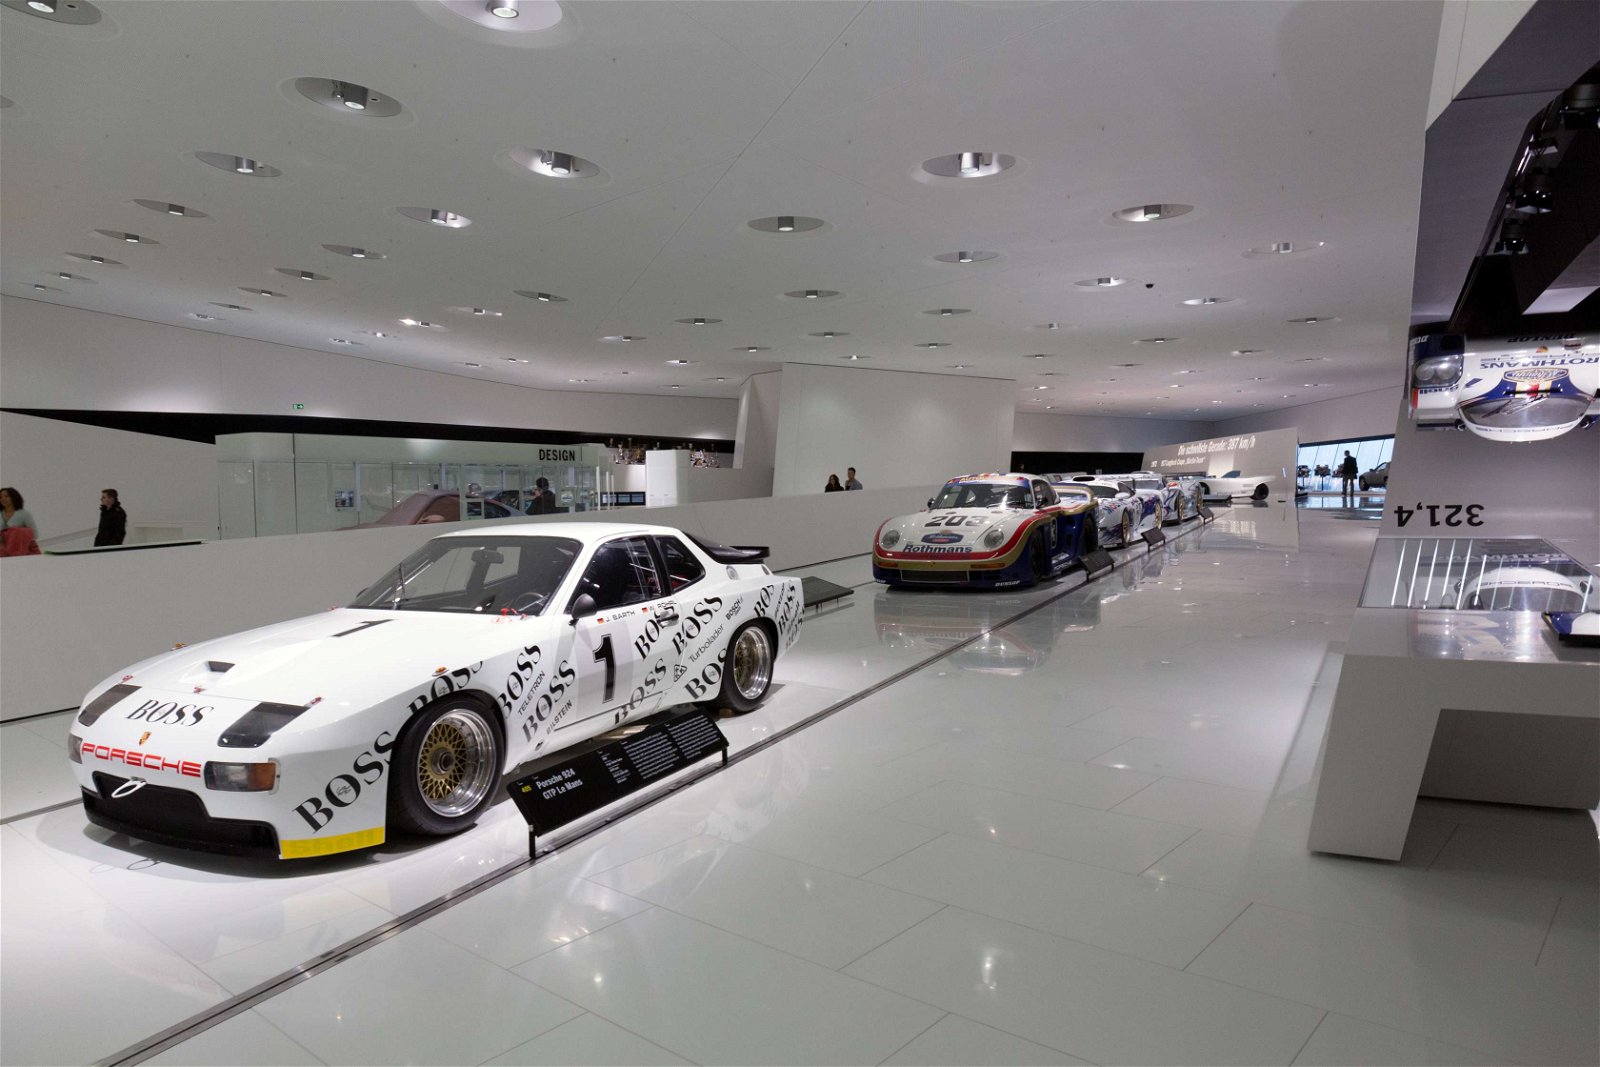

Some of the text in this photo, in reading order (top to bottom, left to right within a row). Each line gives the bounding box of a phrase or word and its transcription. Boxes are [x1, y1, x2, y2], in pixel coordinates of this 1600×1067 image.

[1480, 357, 1600, 369] ROTHMANS
[538, 449, 575, 461] DESIGN
[1393, 502, 1485, 527] 321,4
[903, 544, 973, 553] Rothmans
[612, 611, 635, 621] BARTH
[672, 597, 723, 656] BOSS
[688, 623, 723, 662] Turbolader
[498, 645, 541, 719] BOSS
[592, 633, 616, 704] 1
[517, 670, 546, 716] TELETRON
[522, 660, 576, 742] BOSS
[615, 658, 667, 725] BOSS
[125, 699, 214, 727] BOSS
[546, 700, 573, 734] BILSTEIN
[82, 743, 202, 778] PORSCHE
[292, 731, 396, 834] BOSS
[536, 773, 564, 790] Porsche
[561, 768, 576, 779] 924
[542, 779, 583, 800] GTP Le Mans
